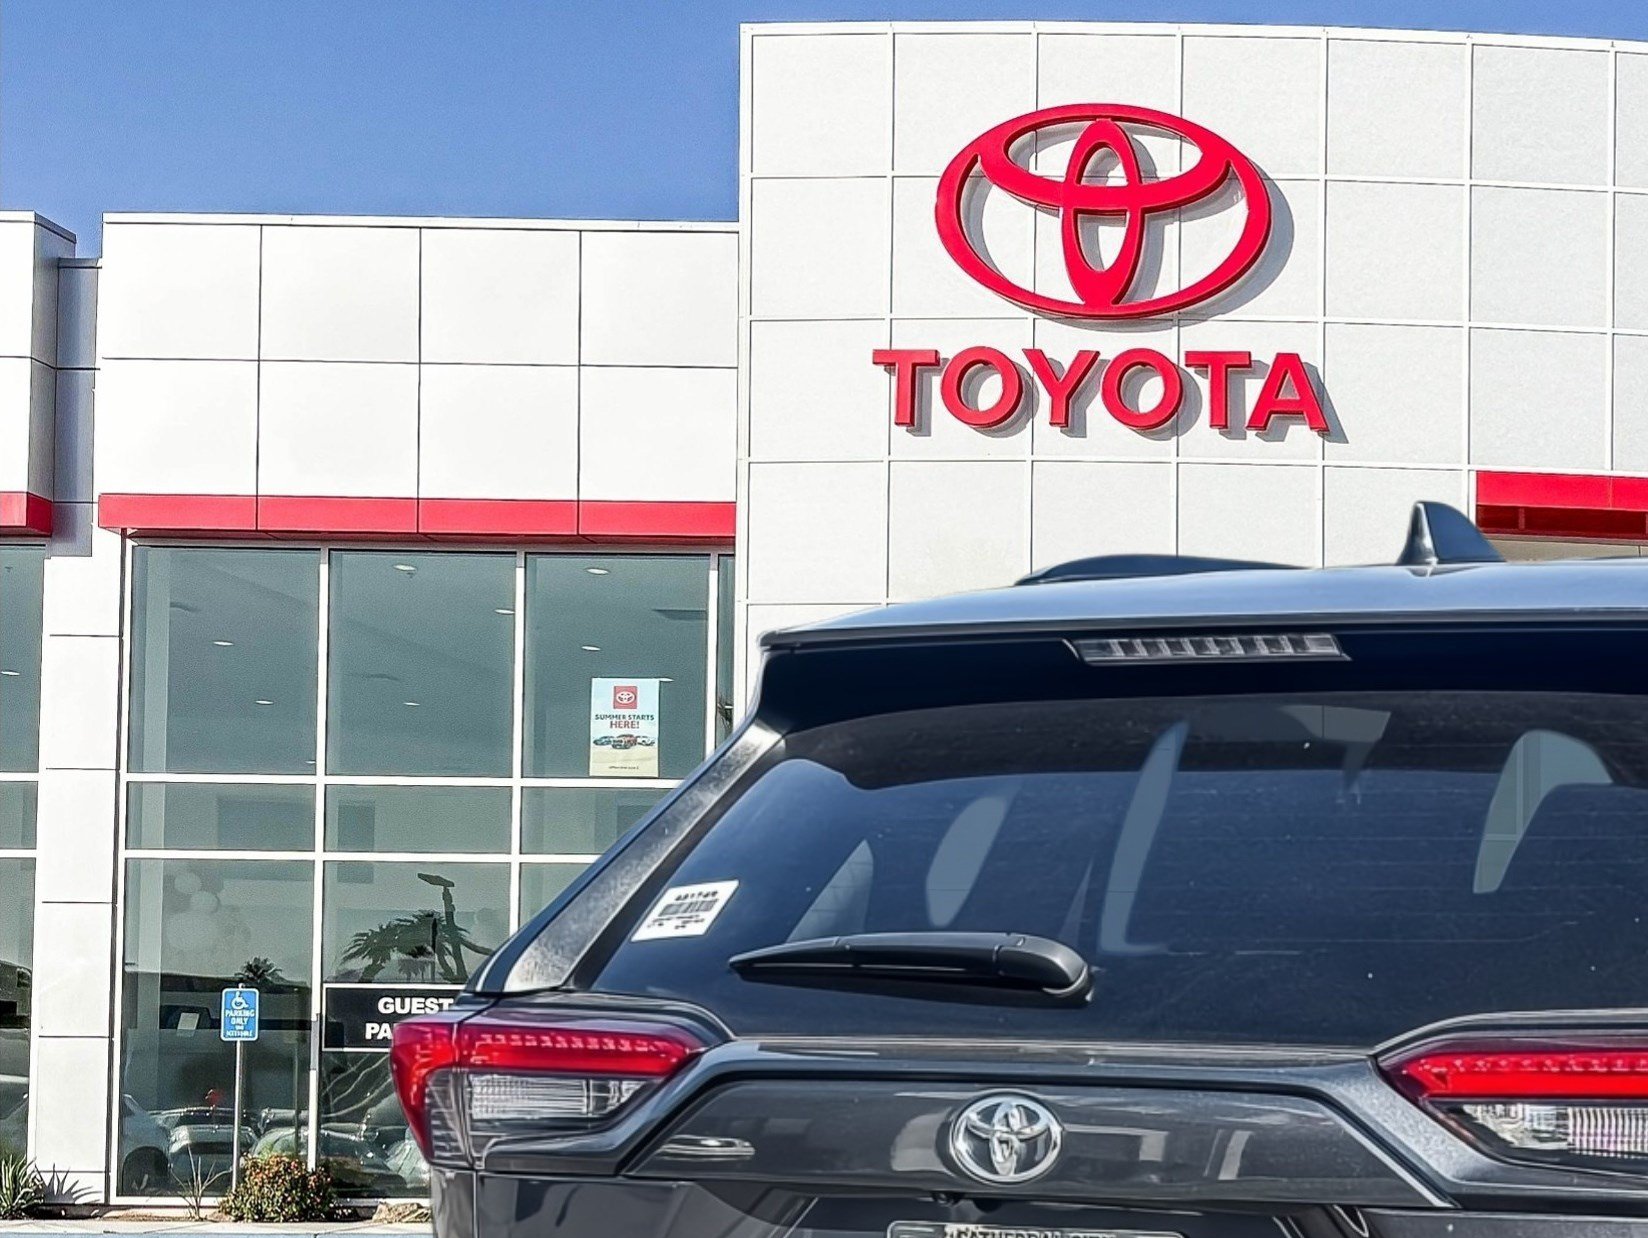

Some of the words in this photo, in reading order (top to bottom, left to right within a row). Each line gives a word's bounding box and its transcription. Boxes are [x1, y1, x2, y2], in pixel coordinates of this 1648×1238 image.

[872, 346, 1329, 433] TOYOTA
[609, 720, 640, 729] HERE!
[377, 997, 455, 1015] GUEST
